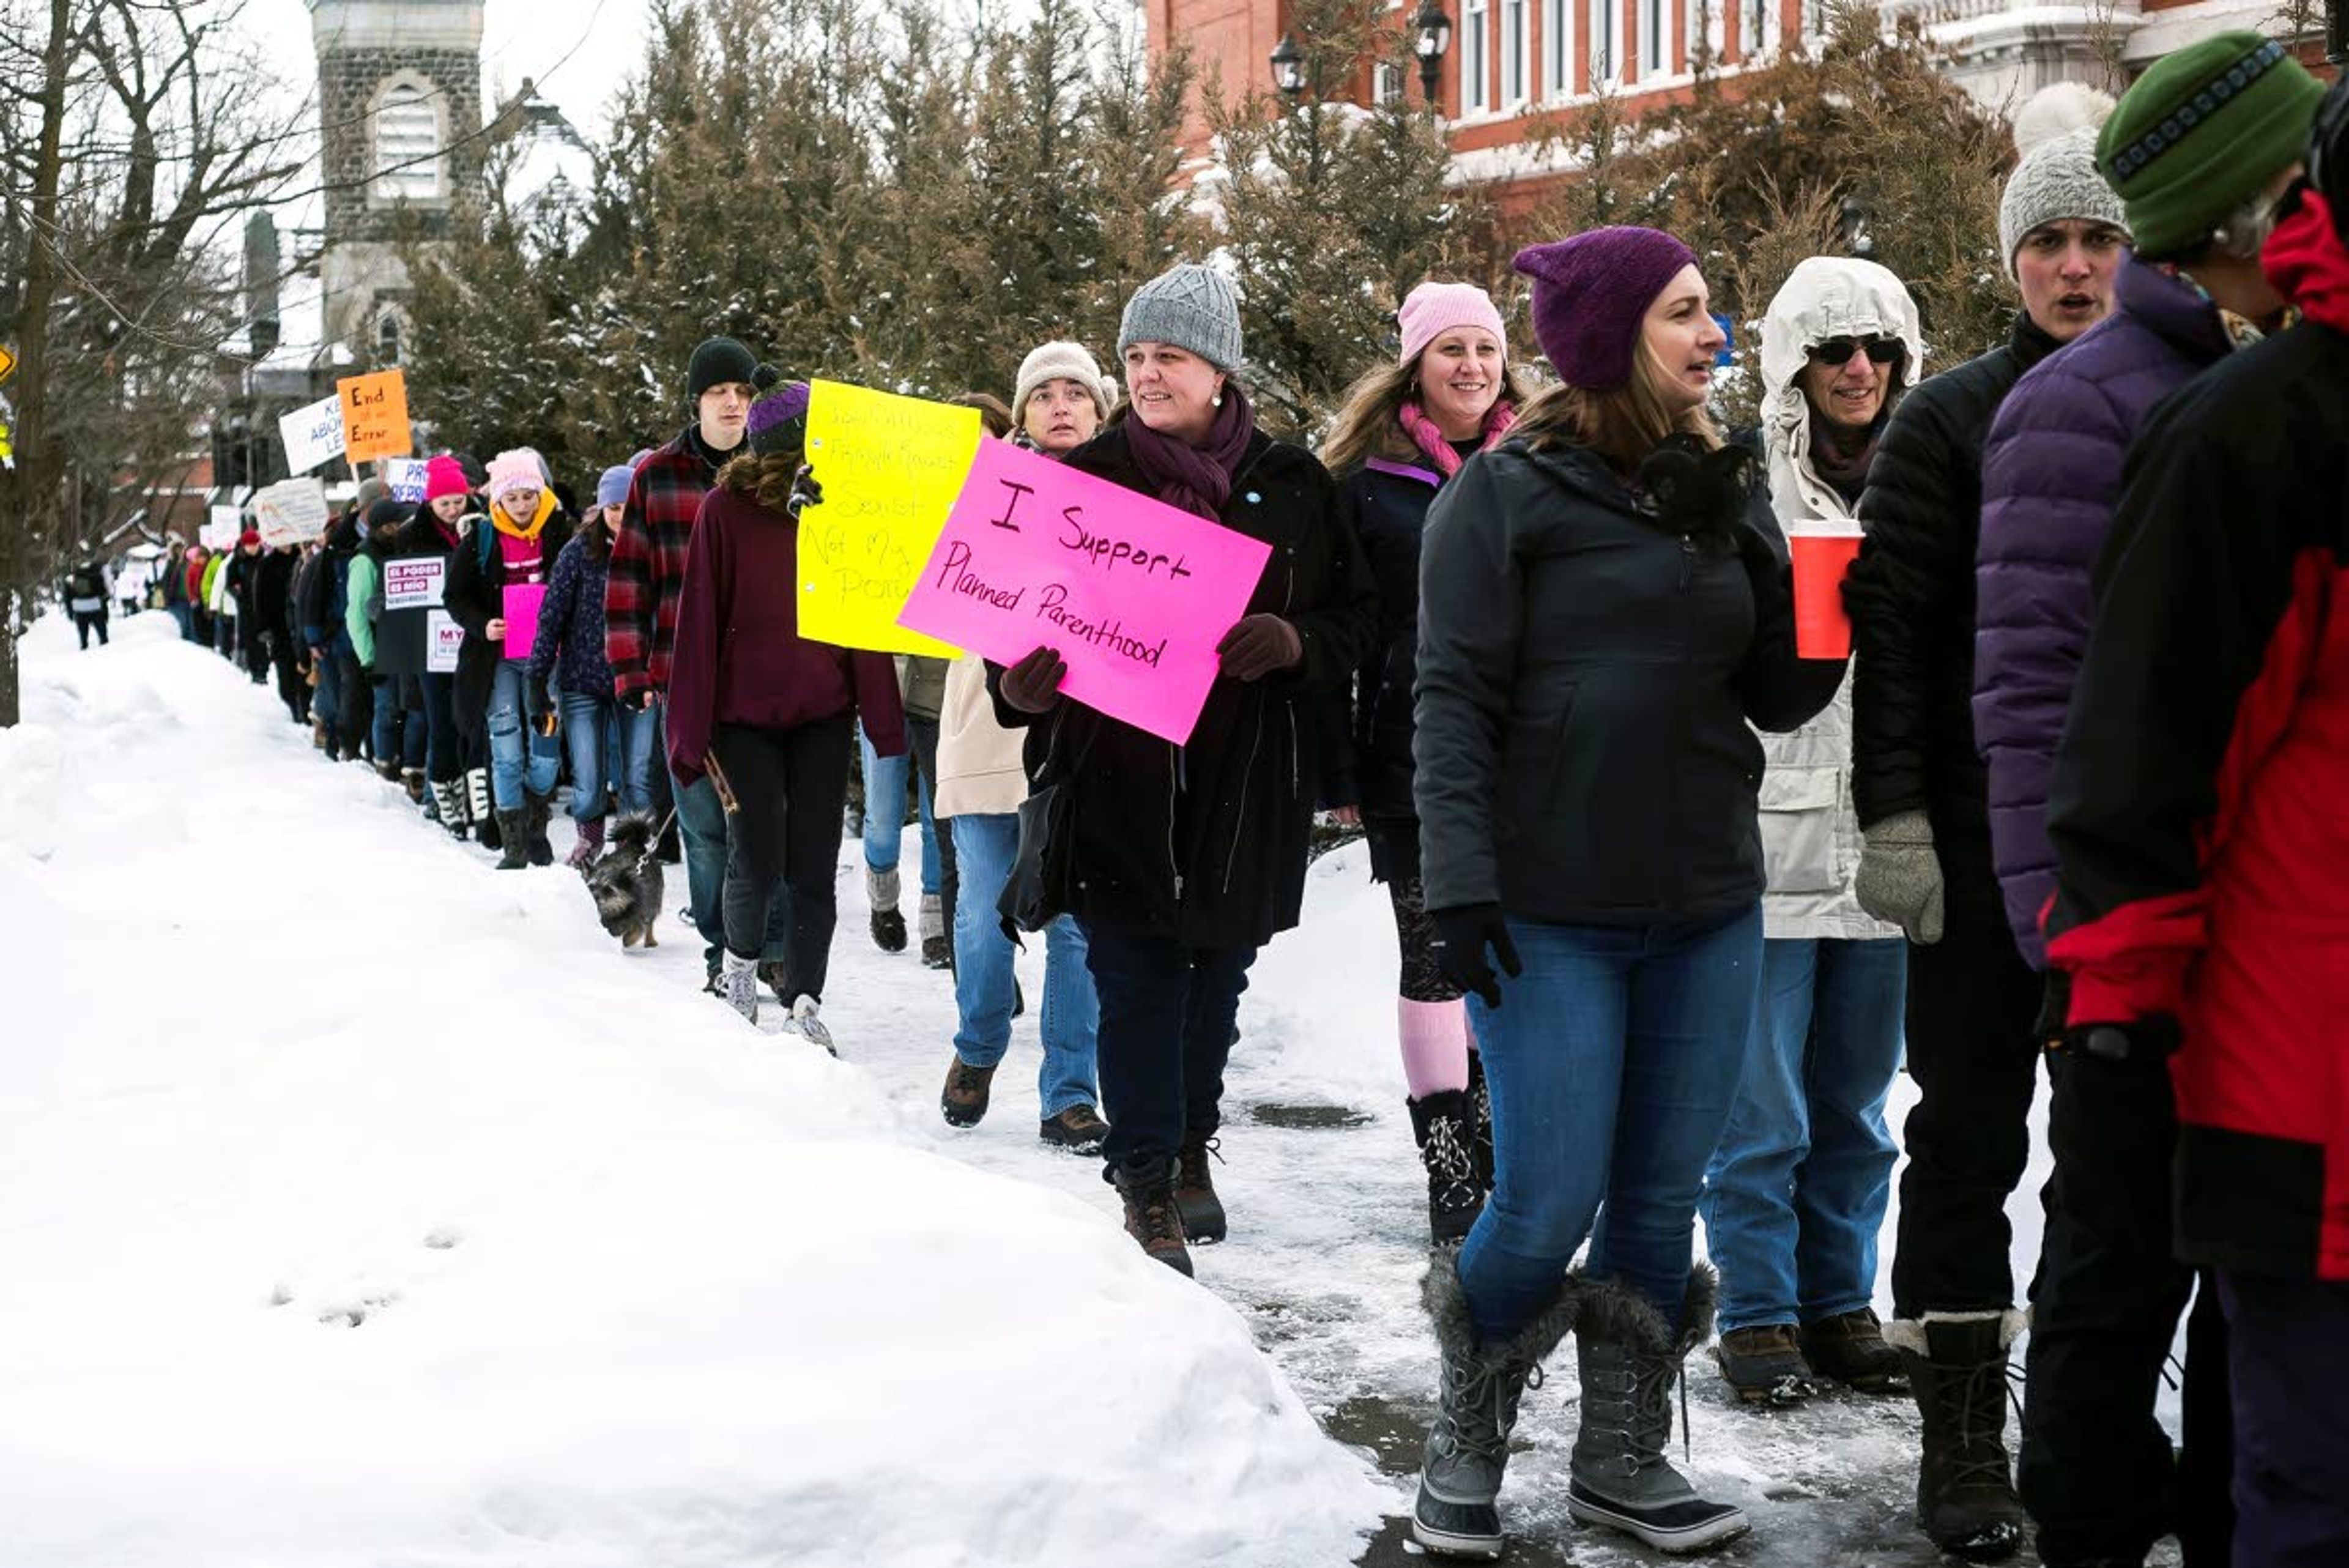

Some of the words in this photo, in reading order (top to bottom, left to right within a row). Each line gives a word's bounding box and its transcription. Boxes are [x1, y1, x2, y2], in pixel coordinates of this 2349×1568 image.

[324, 399, 342, 415] KE
[351, 387, 385, 407] End
[311, 417, 343, 442] ABO
[351, 425, 388, 442] Error
[325, 434, 343, 453] LE
[990, 478, 1034, 532] I
[1058, 507, 1191, 579] Support
[803, 523, 845, 565] Not
[865, 529, 911, 579] My
[403, 565, 439, 578] PODER
[829, 567, 910, 612] POTU
[937, 540, 1025, 612] Planned
[1036, 583, 1167, 668] Parenthood
